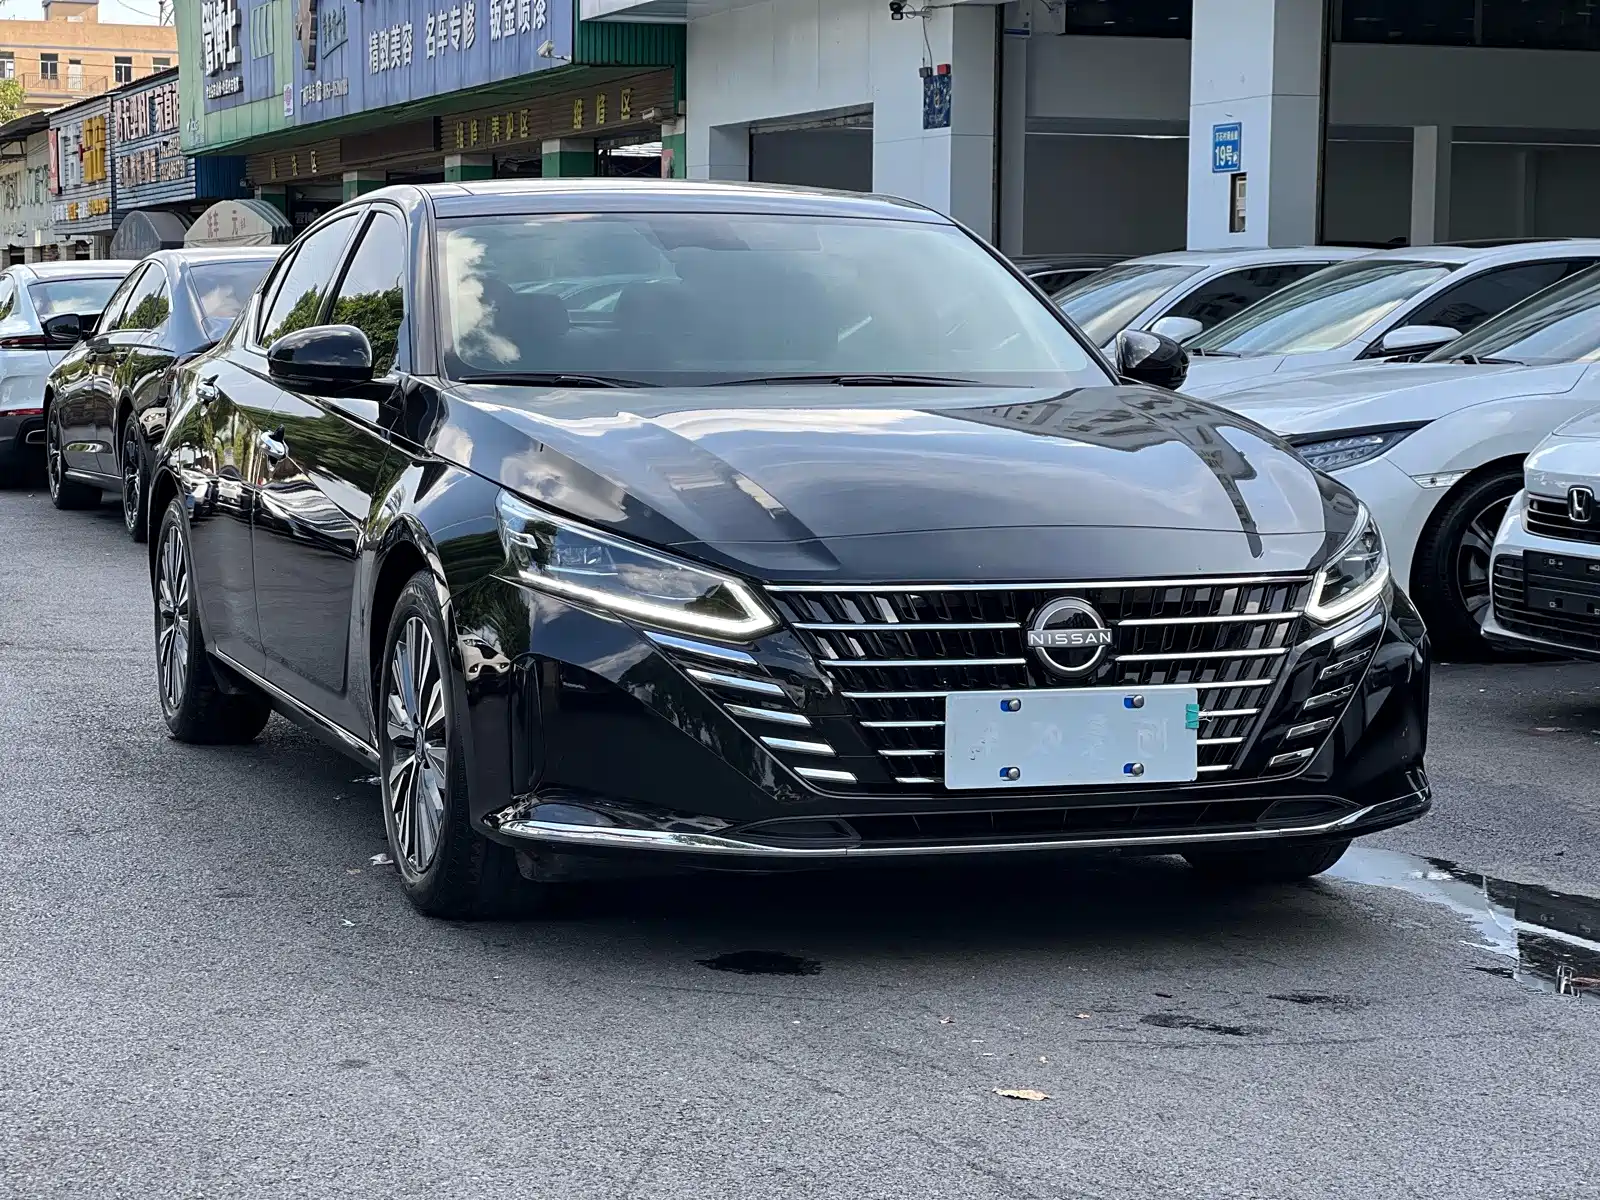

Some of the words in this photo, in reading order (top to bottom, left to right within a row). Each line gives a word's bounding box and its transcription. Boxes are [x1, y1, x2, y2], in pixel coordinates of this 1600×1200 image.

[369, 21, 413, 75] 精致美容
[425, 1, 476, 60] 名车专修
[490, 0, 547, 41] 钣金喷漆
[456, 108, 532, 149] 维修/养护区
[572, 87, 633, 129] 维修区
[1215, 145, 1233, 166] 19号
[1029, 631, 1112, 645] NISSAN
